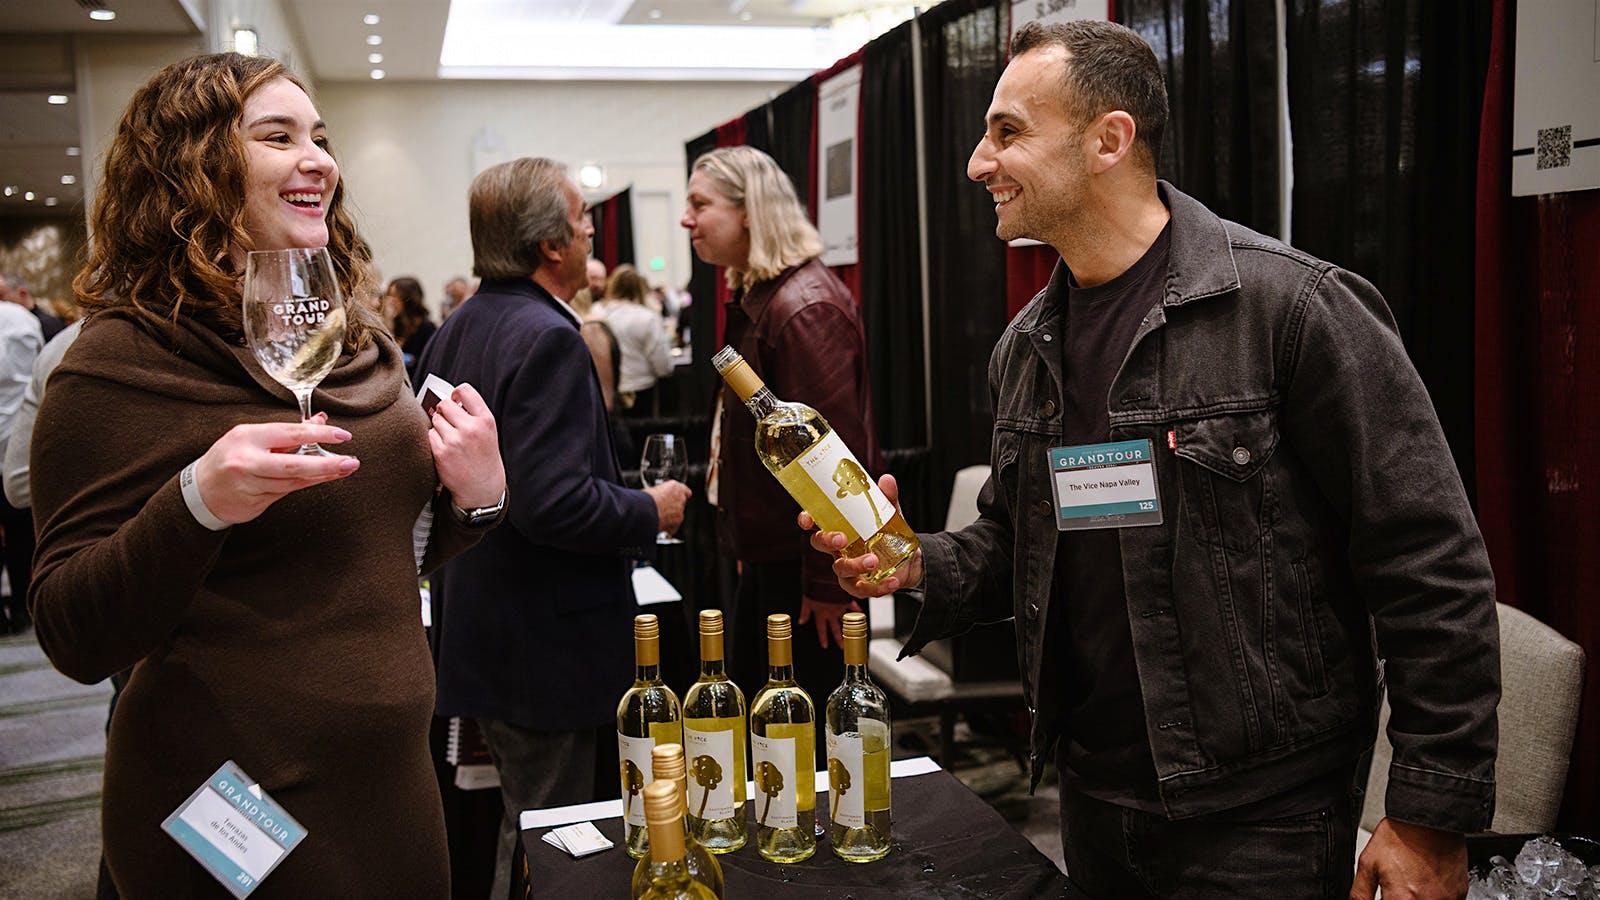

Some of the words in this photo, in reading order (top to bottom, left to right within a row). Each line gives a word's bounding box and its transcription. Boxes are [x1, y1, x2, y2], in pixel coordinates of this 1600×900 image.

[273, 300, 330, 314] GRAND
[281, 312, 325, 326] TOUR
[1083, 482, 1098, 490] Vice
[1099, 480, 1117, 489] Napa
[1118, 478, 1141, 486] Valley
[1138, 501, 1154, 510] 125
[222, 817, 249, 842] Terrazas
[210, 820, 220, 829] de
[218, 825, 229, 839] los
[228, 835, 249, 854] Andes
